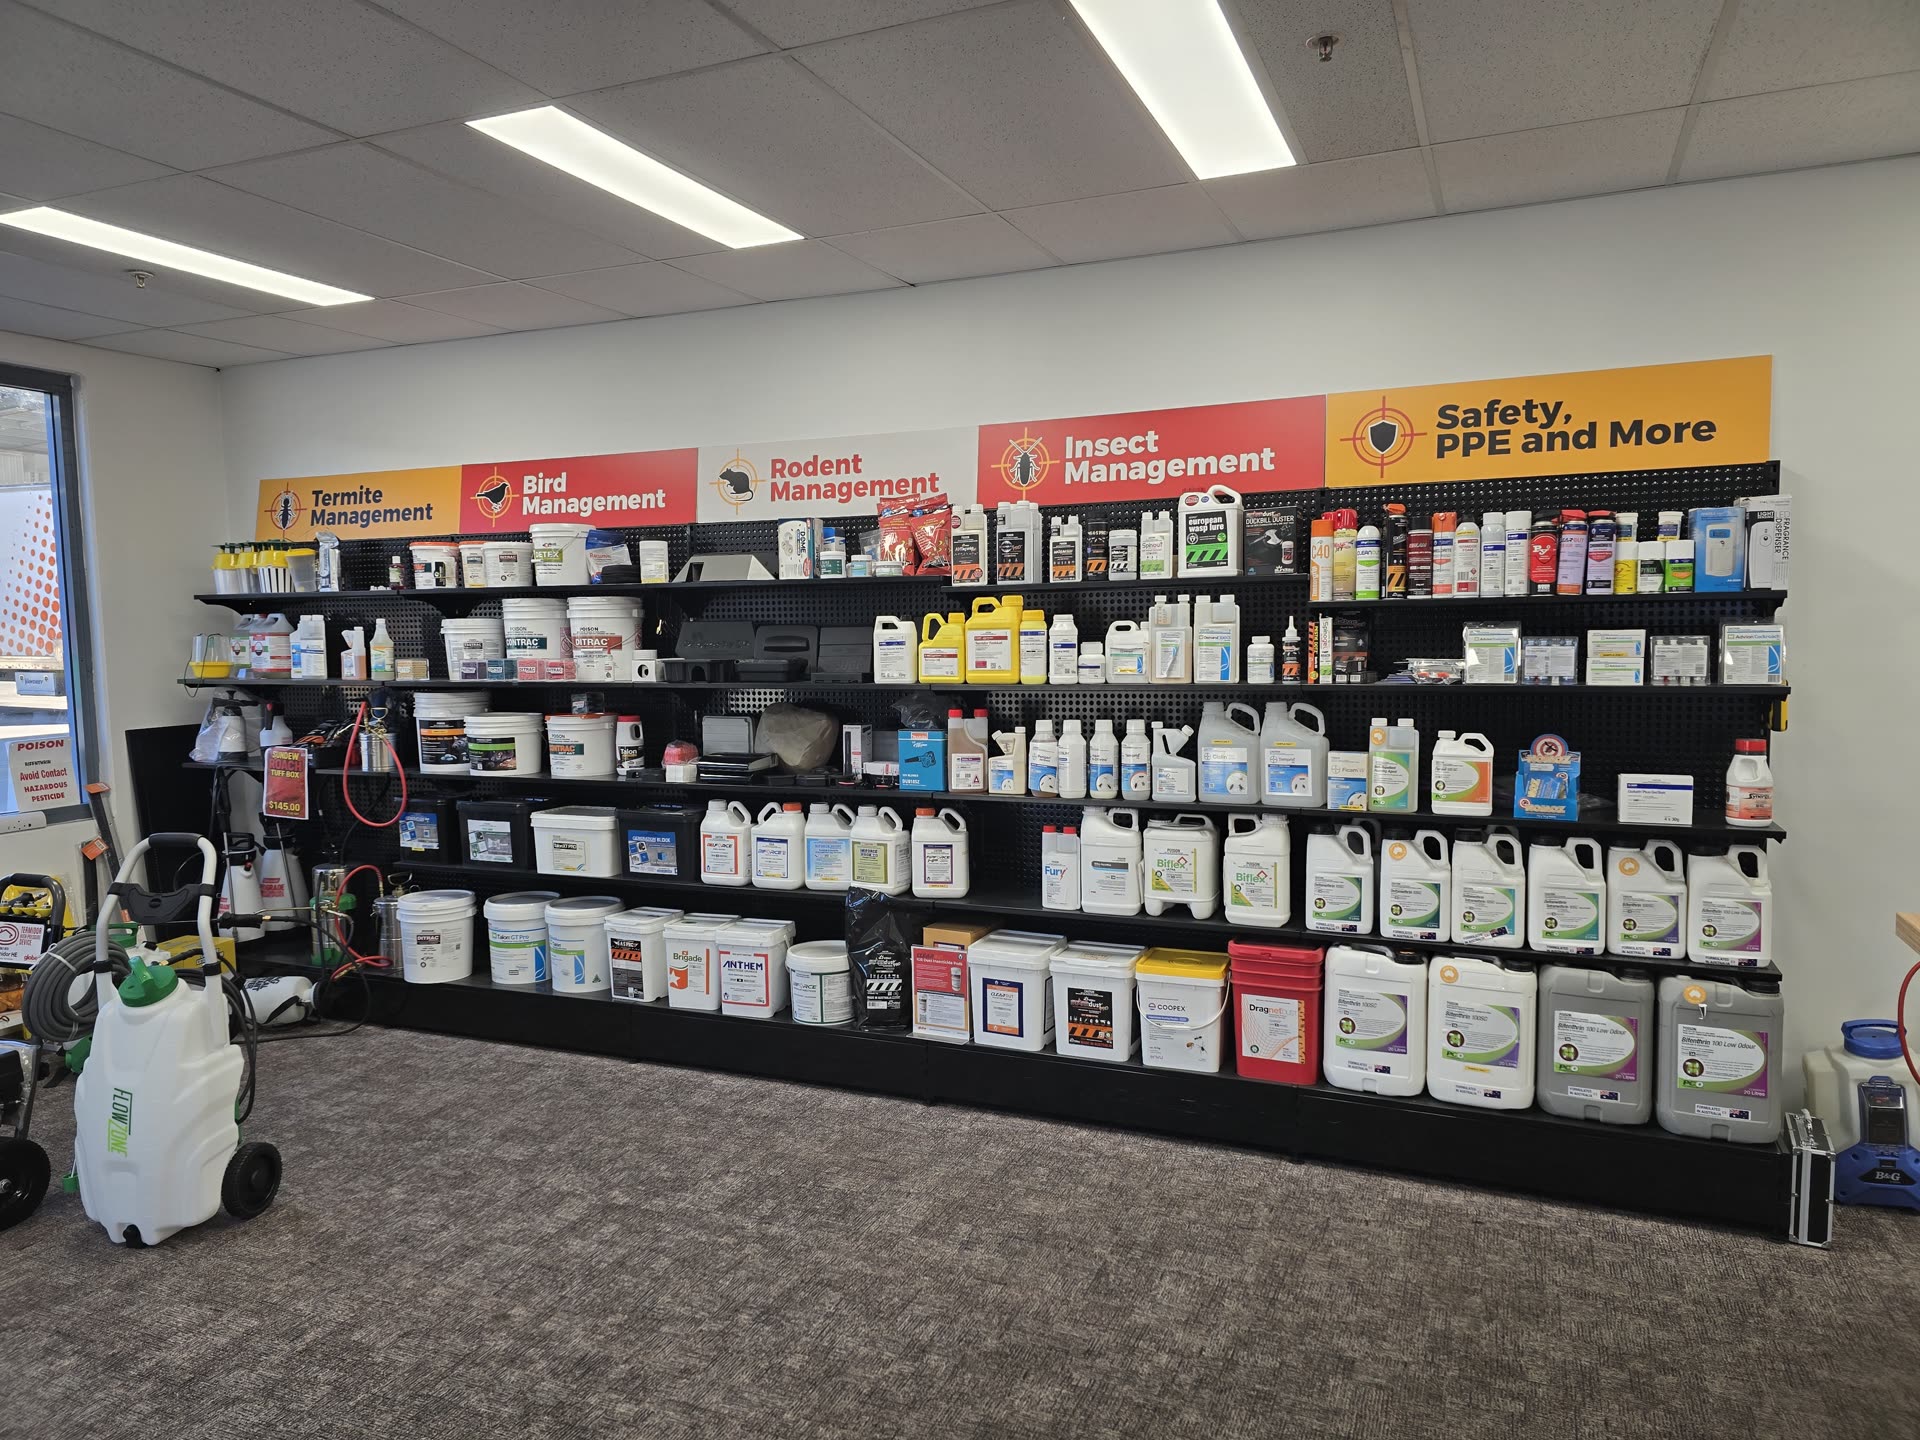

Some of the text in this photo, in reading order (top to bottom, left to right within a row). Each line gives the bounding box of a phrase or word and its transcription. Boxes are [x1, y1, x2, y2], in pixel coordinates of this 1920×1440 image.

[1436, 399, 1573, 430] Safety,
[1065, 430, 1159, 459] Insect
[1436, 418, 1717, 459] PPE and More
[770, 454, 863, 479] Rodent
[1065, 447, 1275, 485] Management
[523, 471, 567, 495] Bird
[770, 472, 940, 505] Management
[311, 485, 383, 507] Termite
[522, 488, 666, 517] Management
[310, 503, 433, 528] Management
[1188, 516, 1223, 525] european
[1246, 515, 1295, 525] DUCKBILL DUSTER
[1188, 521, 1225, 533] wasp lure
[1311, 544, 1330, 559] C40
[506, 638, 539, 646] CONTRAC
[575, 638, 608, 646] DITRAC
[16, 738, 65, 752] POISON
[271, 751, 299, 760] SUNDEW
[270, 760, 303, 772] ROACH
[20, 767, 67, 781] Avoid Contact
[286, 771, 300, 779] BOX
[24, 781, 68, 793] HAZARDOUS
[31, 791, 65, 803] PESTICIDE
[269, 801, 300, 812] $145.00
[1157, 858, 1186, 870] Biflex
[1045, 865, 1067, 880] Fury
[1236, 872, 1266, 883] Biflex
[21, 926, 42, 934] TERMIDOR
[673, 952, 702, 963] Brigade
[723, 960, 763, 970] ANTHEM
[1157, 1003, 1186, 1012] COOPEX
[1558, 1022, 1584, 1031] Bifenthrin
[1682, 1036, 1711, 1046] Bifenthrin
[111, 1087, 132, 1158] FLOWZONE
[1875, 1171, 1901, 1182] B&G
